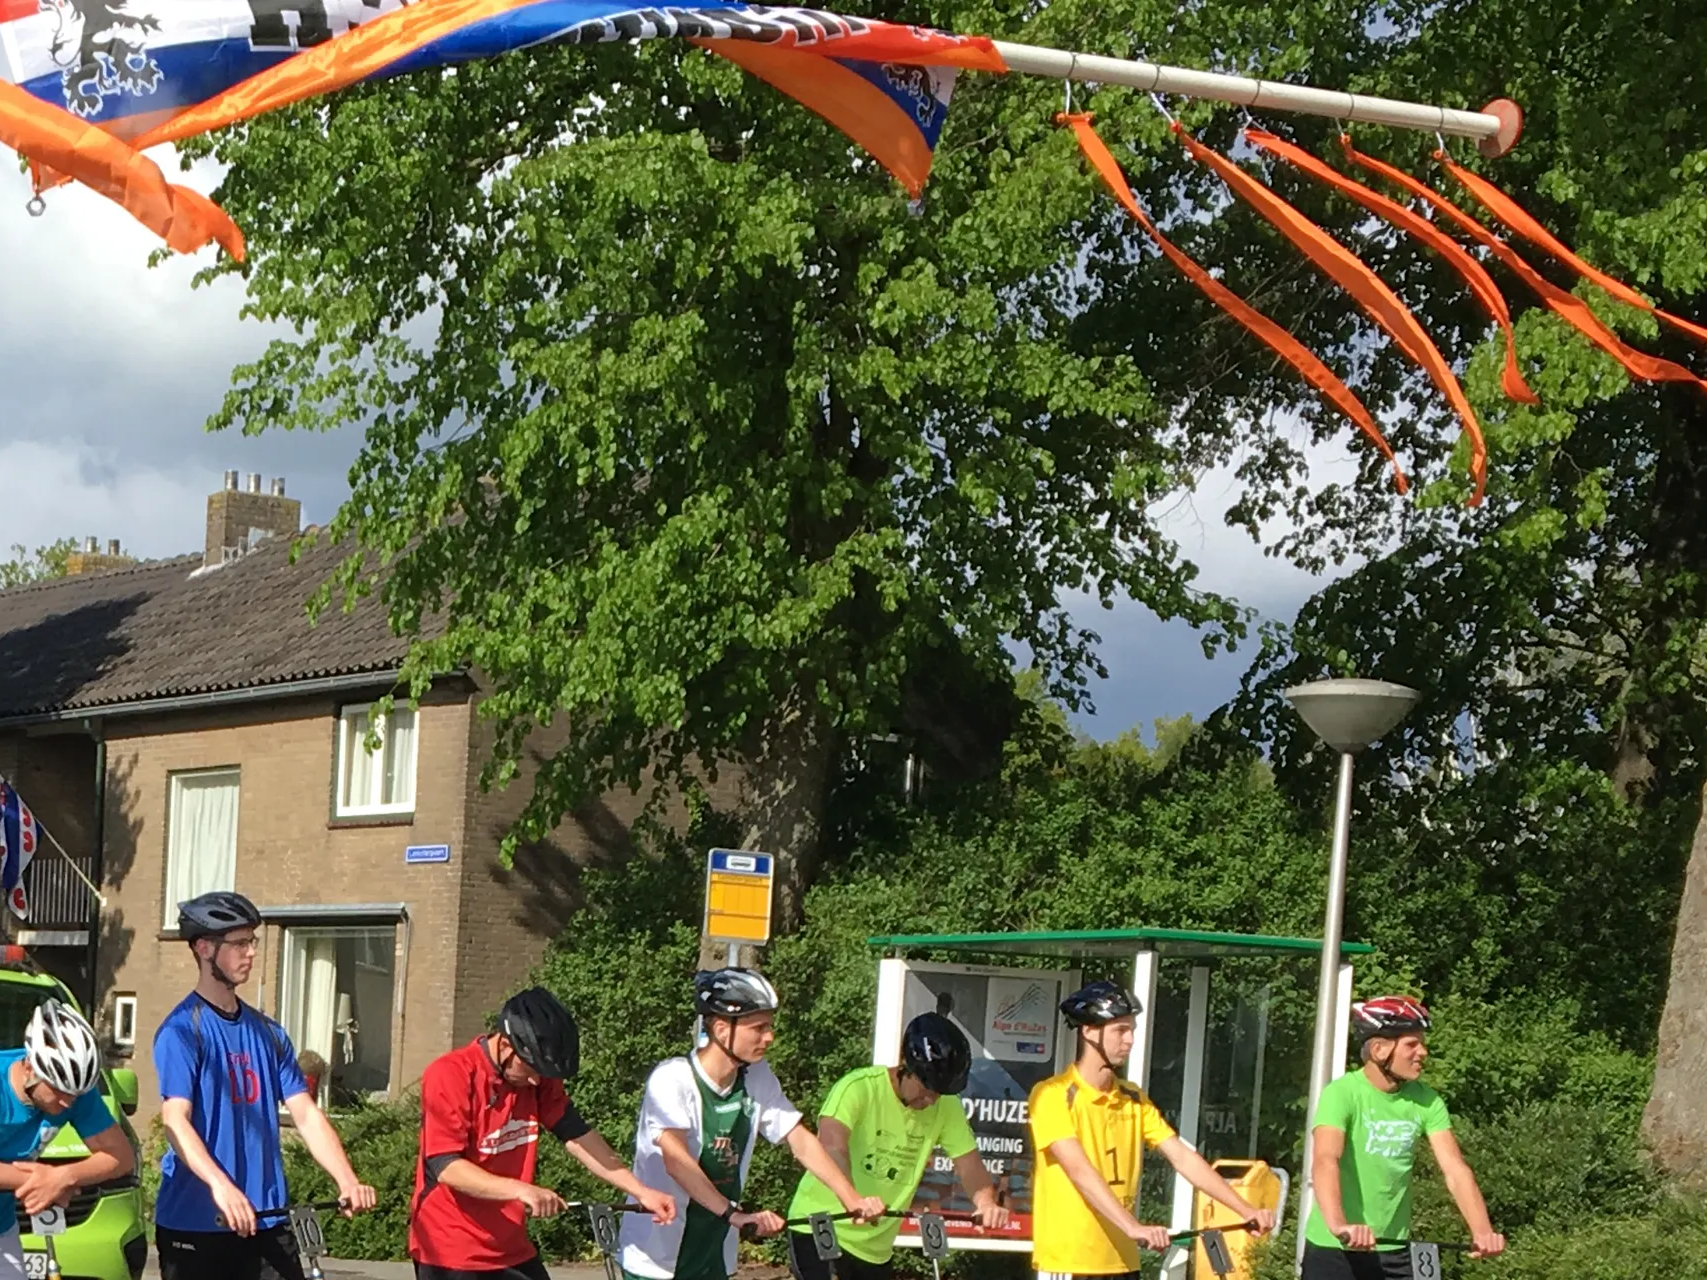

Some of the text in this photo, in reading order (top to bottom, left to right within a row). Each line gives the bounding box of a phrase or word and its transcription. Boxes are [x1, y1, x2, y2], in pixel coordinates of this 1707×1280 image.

[962, 1098, 1034, 1124] D'HUZE
[1106, 1147, 1125, 1185] 1
[296, 1217, 321, 1247] 10
[817, 1220, 834, 1249] 5
[926, 1223, 943, 1249] 9
[25, 1255, 44, 1273] 63
[1210, 1238, 1226, 1266] 1
[1418, 1251, 1435, 1278] 8
